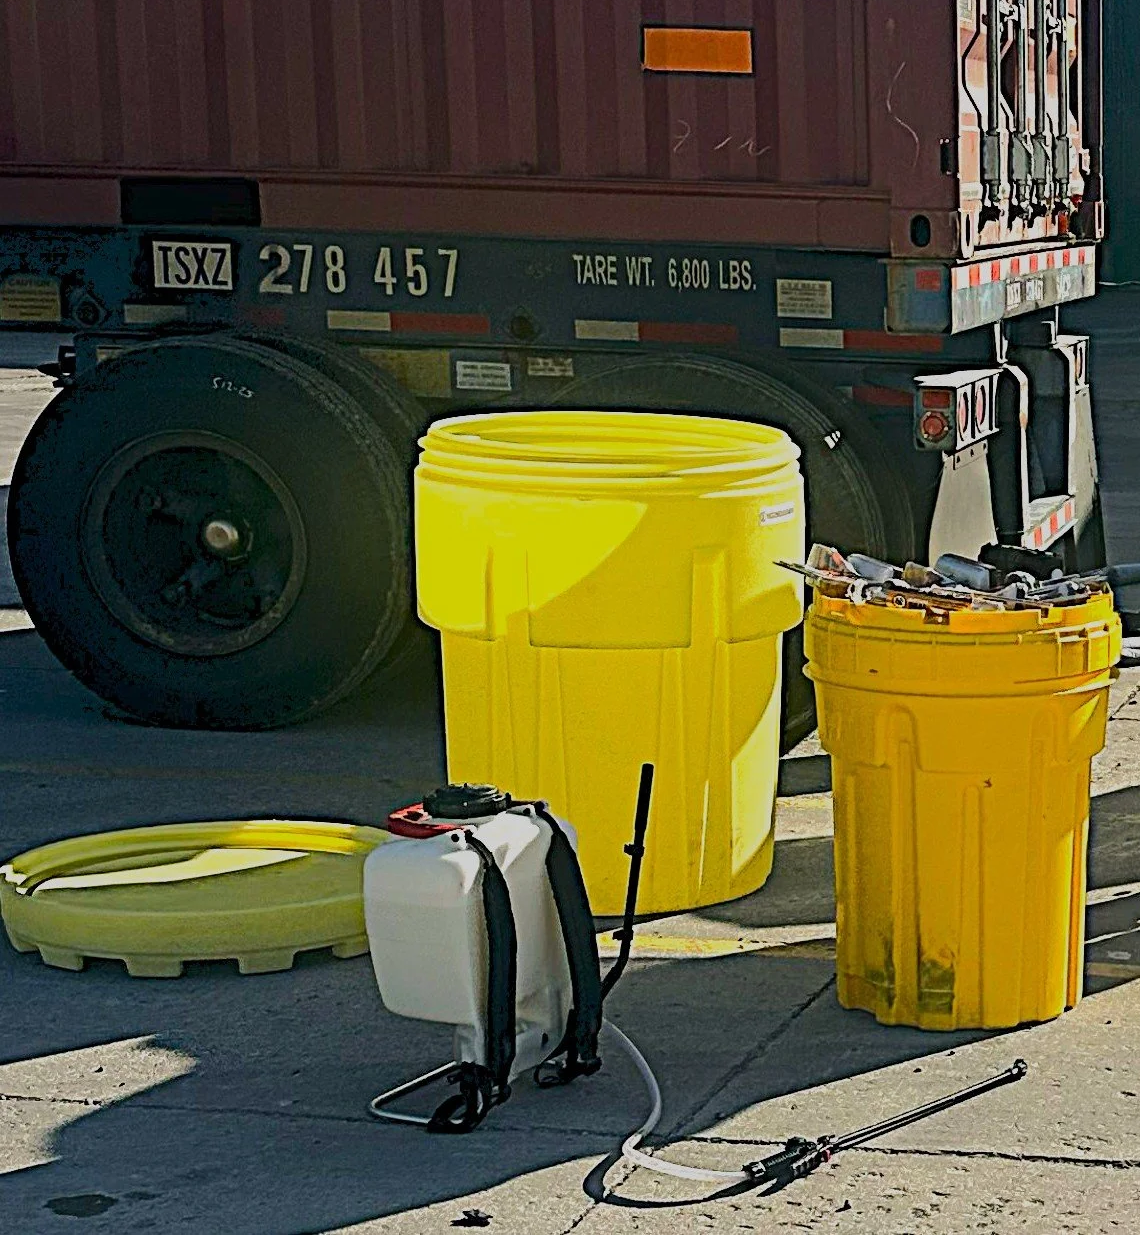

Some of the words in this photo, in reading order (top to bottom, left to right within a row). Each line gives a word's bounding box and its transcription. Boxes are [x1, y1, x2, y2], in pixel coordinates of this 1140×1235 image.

[158, 246, 228, 286] TSXZ
[259, 243, 347, 294] 278
[374, 246, 458, 297] 457
[572, 254, 617, 286] TARE
[625, 256, 655, 287] WT.
[668, 258, 710, 292] 6,800
[719, 260, 757, 290] LBS.
